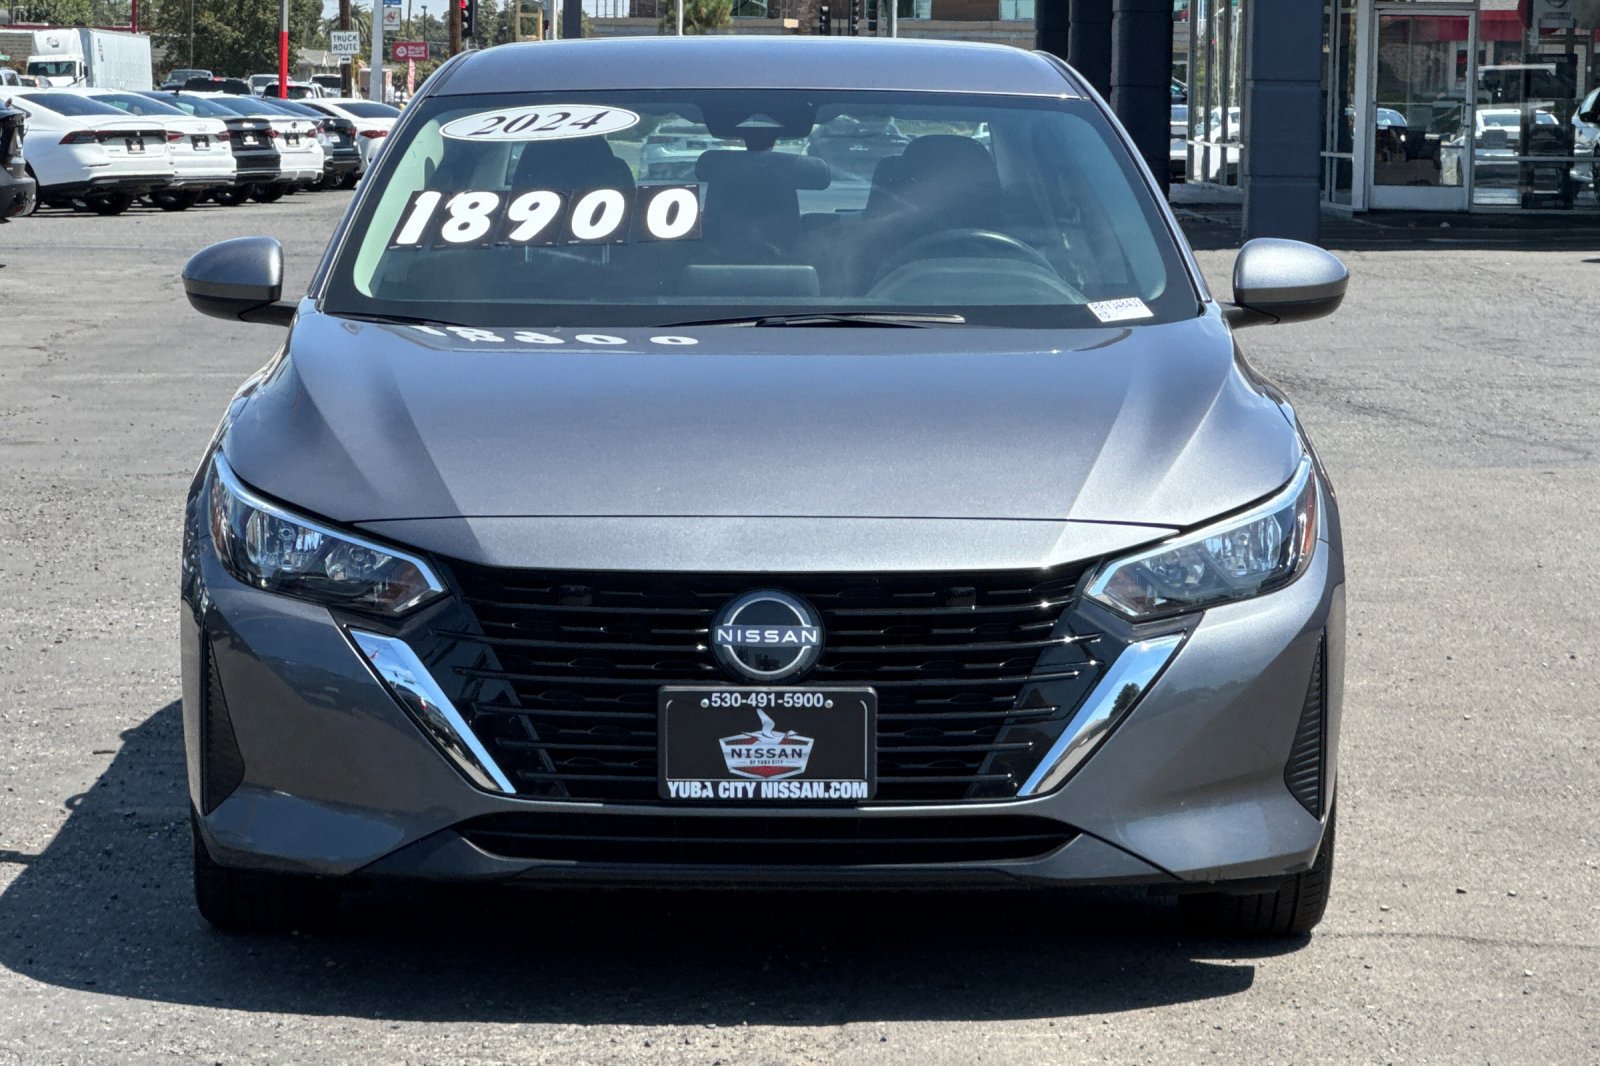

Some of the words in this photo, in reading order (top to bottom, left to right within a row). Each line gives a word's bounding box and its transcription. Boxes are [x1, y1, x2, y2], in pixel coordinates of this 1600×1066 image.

[333, 43, 358, 51] ROUTE
[468, 110, 611, 136] 2024
[396, 188, 699, 245] 18900
[717, 628, 818, 643] NISSAN
[711, 692, 825, 708] 530-491-5900
[730, 748, 803, 759] NISSAN
[667, 781, 714, 799] YUBA
[718, 781, 756, 799] CITY
